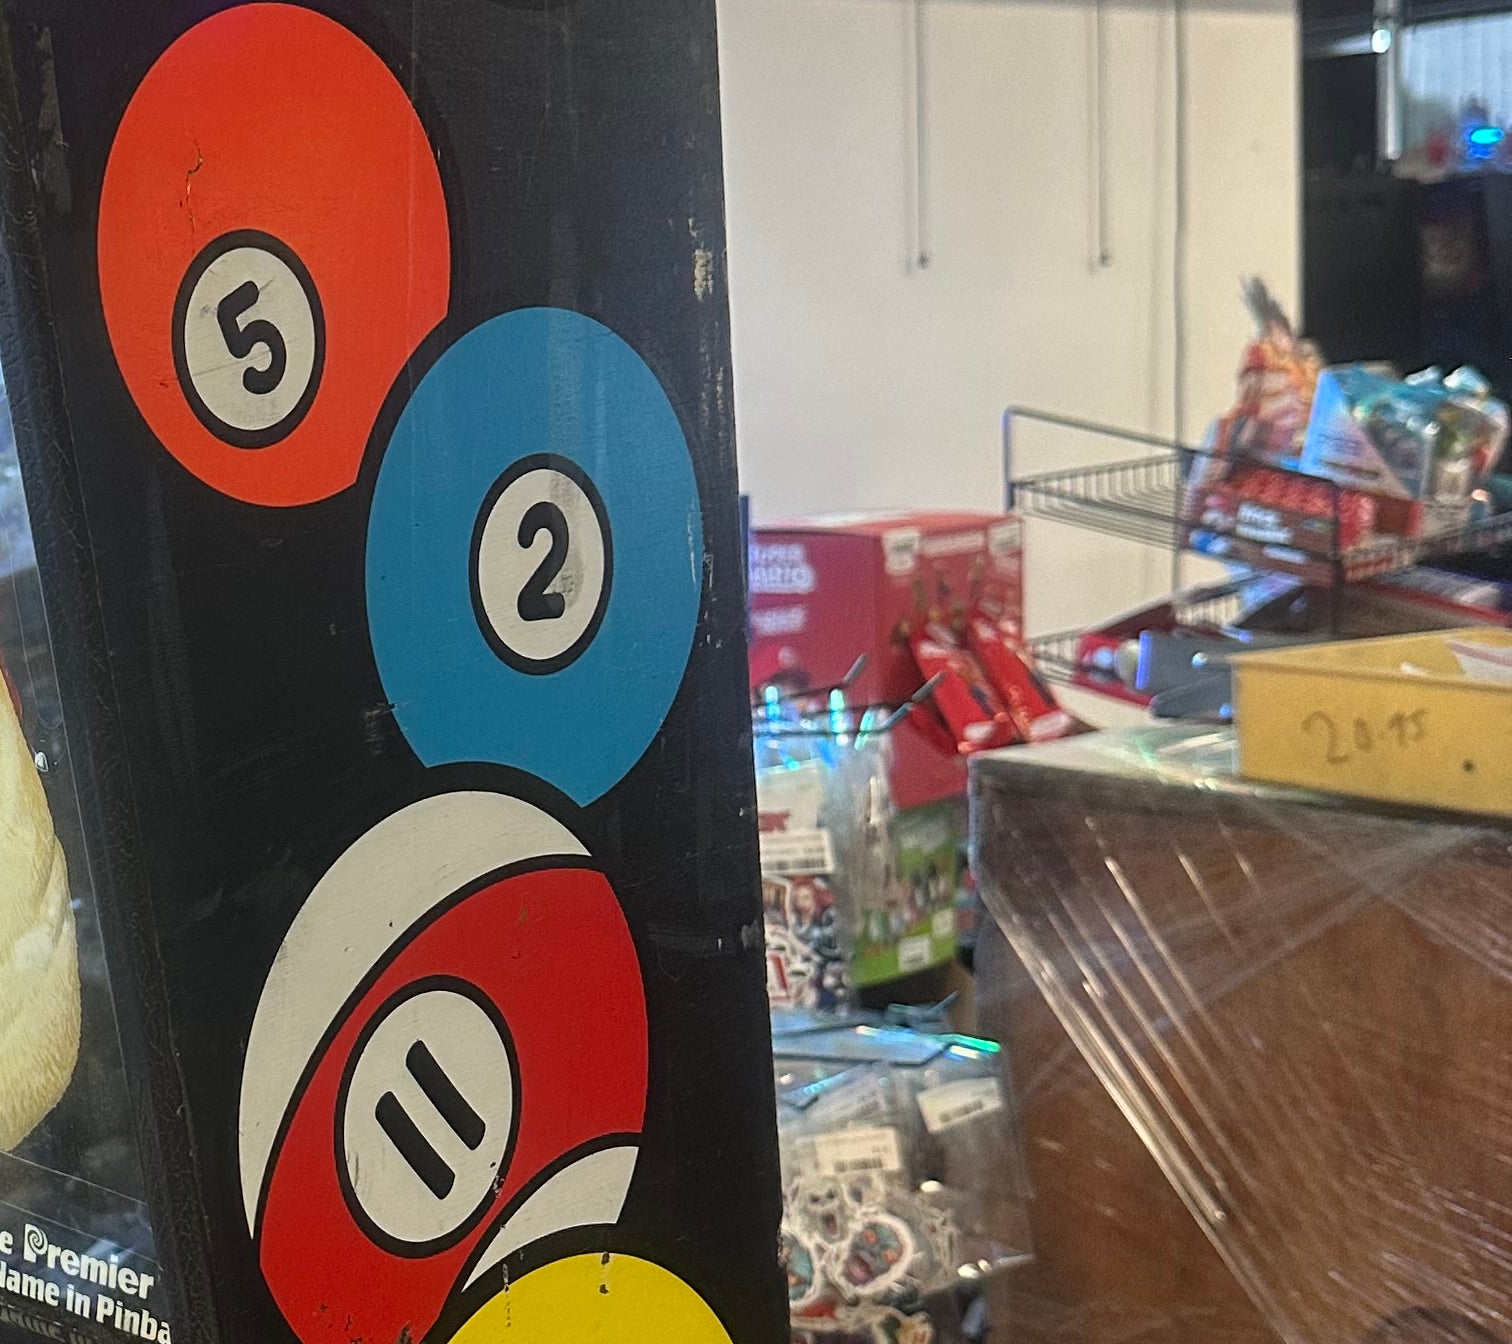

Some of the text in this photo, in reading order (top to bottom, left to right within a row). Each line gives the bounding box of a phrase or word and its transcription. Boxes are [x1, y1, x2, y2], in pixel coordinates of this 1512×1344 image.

[217, 281, 286, 394] 5
[517, 501, 569, 621] 2
[375, 1039, 486, 1200] 11
[22, 1222, 155, 1301] Premier
[65, 1282, 92, 1320] in
